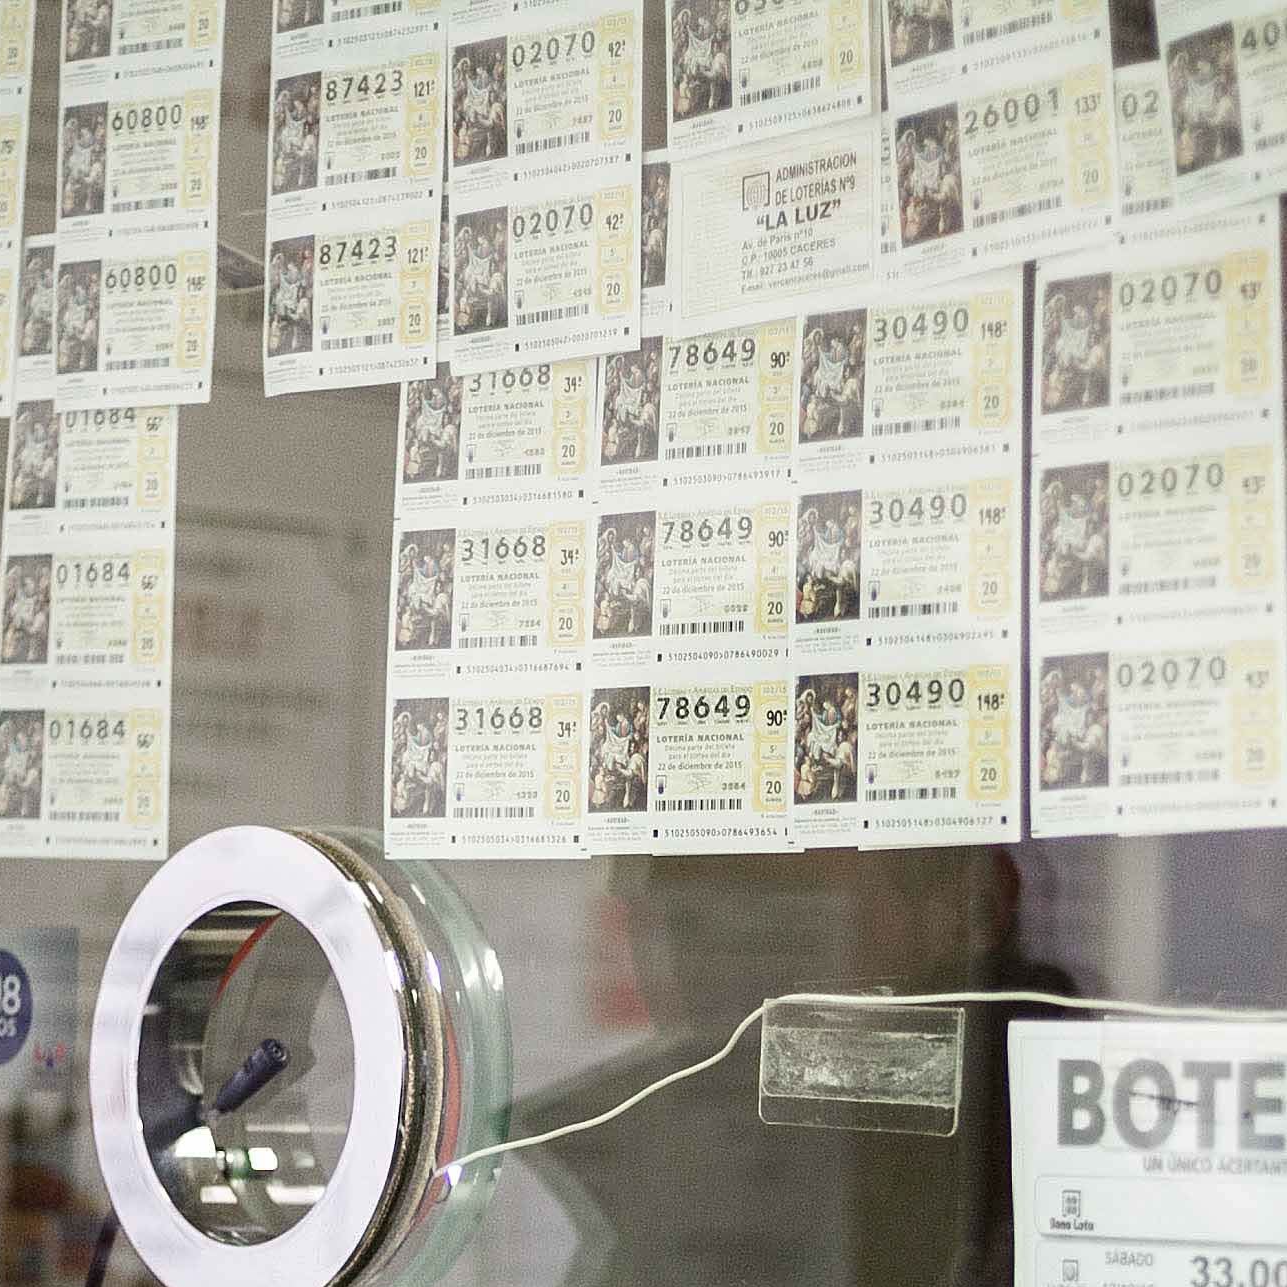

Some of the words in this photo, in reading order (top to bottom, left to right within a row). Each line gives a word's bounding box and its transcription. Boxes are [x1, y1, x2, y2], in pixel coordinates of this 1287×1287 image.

[512, 30, 596, 68] 02070
[325, 70, 403, 102] 87423
[112, 104, 183, 131] 60800
[964, 87, 1059, 136] 26001
[776, 152, 857, 183] ADMINISTRACION
[775, 190, 787, 206] DE
[513, 203, 594, 238] 02070
[319, 236, 397, 265] 87423
[104, 264, 178, 290] 60800
[1118, 269, 1222, 308] 02070
[873, 308, 969, 343] 30490
[668, 337, 756, 369] 78649
[1117, 464, 1224, 498] 02070
[869, 493, 967, 525] 30490
[663, 517, 753, 545] 78649
[463, 535, 546, 562] 31668
[701, 555, 746, 565] NACIONAL
[57, 562, 131, 585] 01684
[1117, 656, 1227, 689] 02070
[657, 694, 750, 721] 78649
[866, 678, 966, 708] 30490
[50, 718, 126, 742] 01684
[455, 706, 543, 731] 31668
[656, 733, 694, 744] LOTERÍA
[697, 732, 745, 743] NACIONAL
[657, 763, 667, 772] 22
[668, 761, 676, 771] de
[678, 760, 712, 771] diciembre
[714, 761, 723, 770] de
[725, 760, 743, 770] 2015
